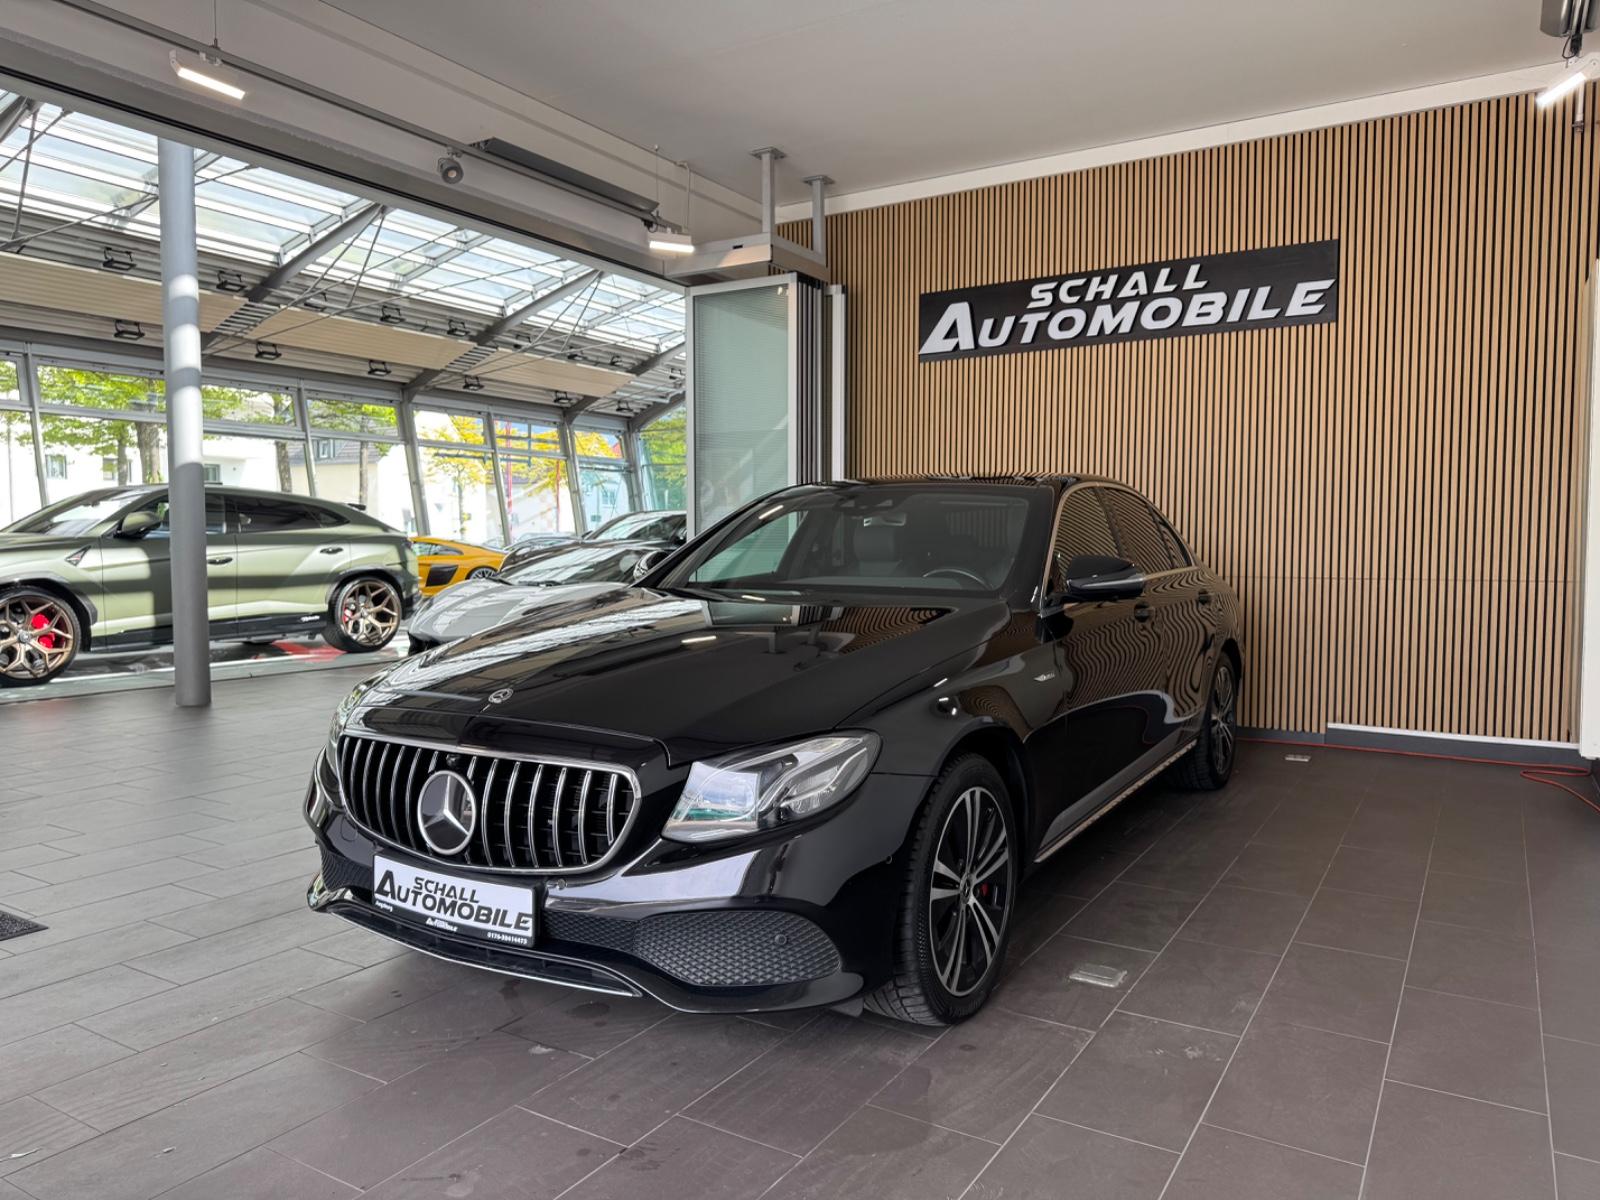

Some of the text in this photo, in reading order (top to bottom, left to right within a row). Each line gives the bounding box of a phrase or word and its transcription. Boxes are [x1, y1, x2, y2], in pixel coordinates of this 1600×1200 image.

[1026, 264, 1209, 309] SCHALL
[918, 278, 1336, 355] AUTOMOBILE
[374, 869, 532, 931] AUTOMOBILE
[413, 876, 480, 903] SCHALL
